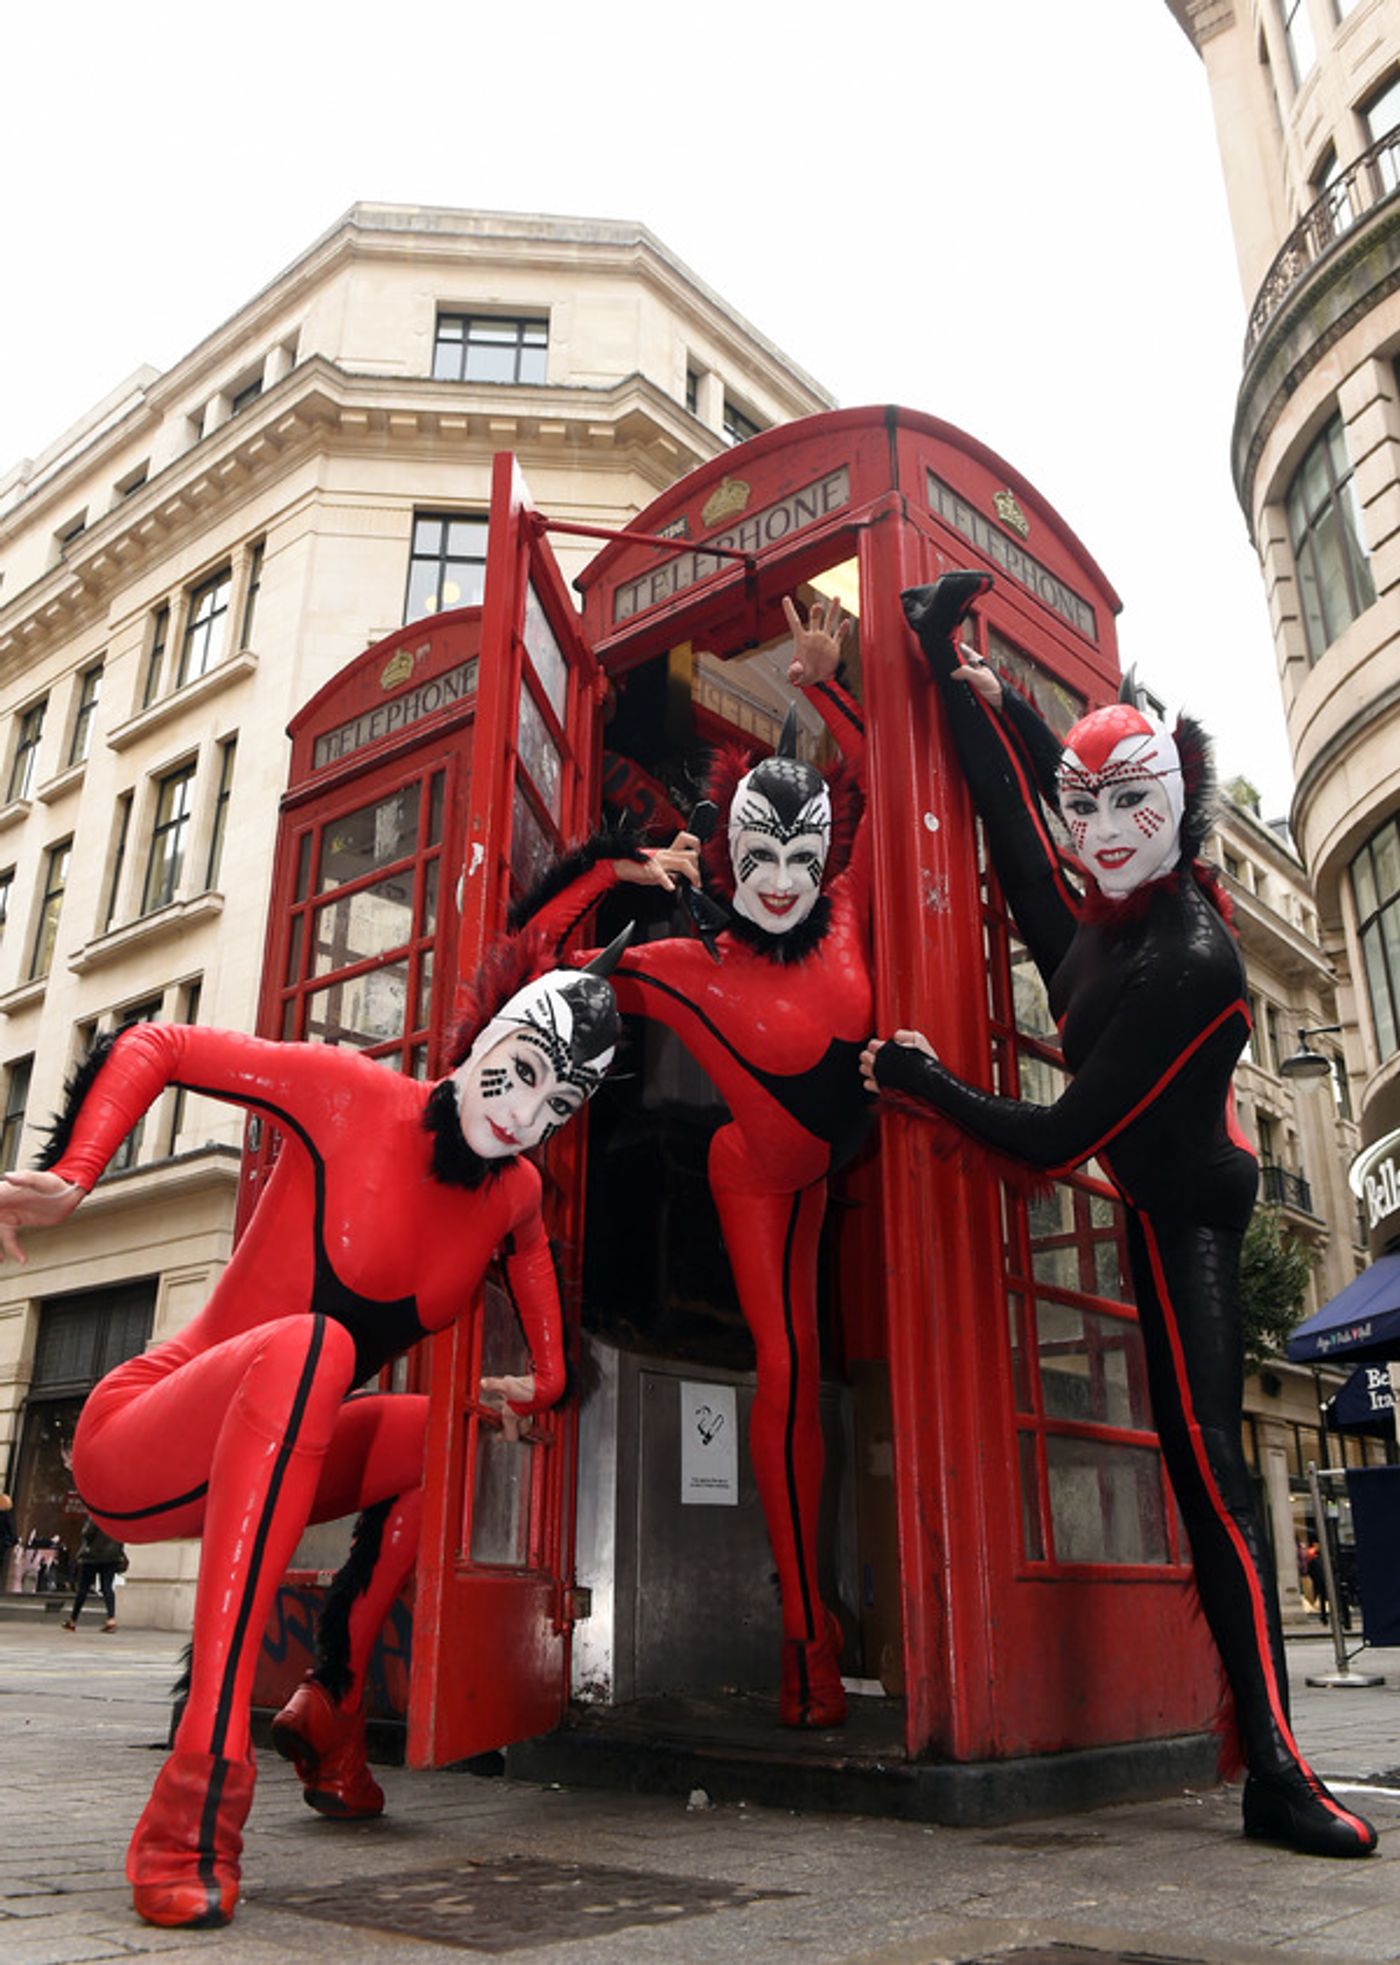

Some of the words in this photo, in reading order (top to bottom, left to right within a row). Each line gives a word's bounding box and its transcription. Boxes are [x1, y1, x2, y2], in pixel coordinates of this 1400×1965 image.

[932, 480, 1087, 628] TELEPHONE
[324, 662, 477, 762] TELEPHONE
[1366, 1157, 1400, 1229] Bell
